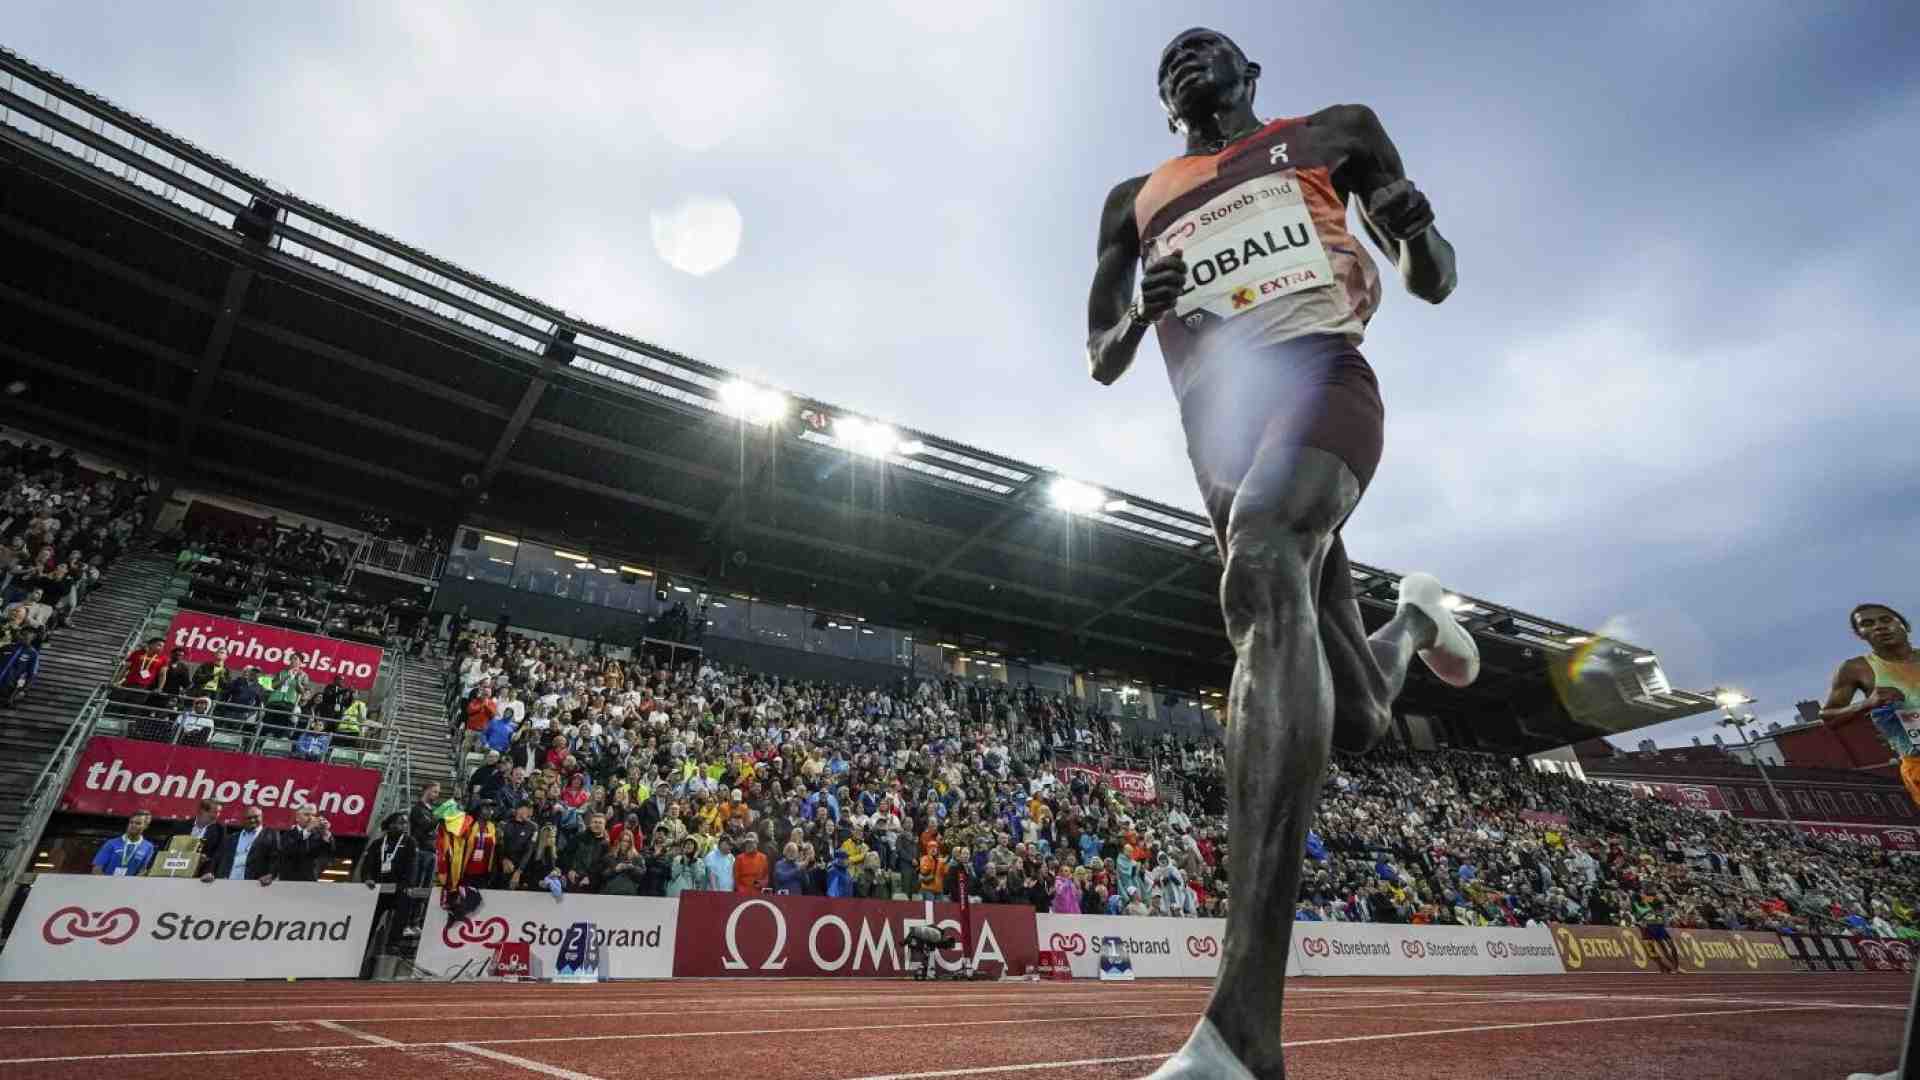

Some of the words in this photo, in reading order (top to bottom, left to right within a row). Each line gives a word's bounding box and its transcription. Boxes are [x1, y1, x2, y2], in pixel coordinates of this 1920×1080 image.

[1199, 181, 1292, 227] Storebrand
[1260, 269, 1317, 296] EXTRA
[86, 759, 366, 817] thonhotels.no
[151, 911, 352, 942] Storebrand
[568, 927, 583, 951] 2
[1332, 939, 1391, 956] Storebrand
[1426, 941, 1479, 957] Storebrand
[1581, 937, 1625, 959] EXTRA
